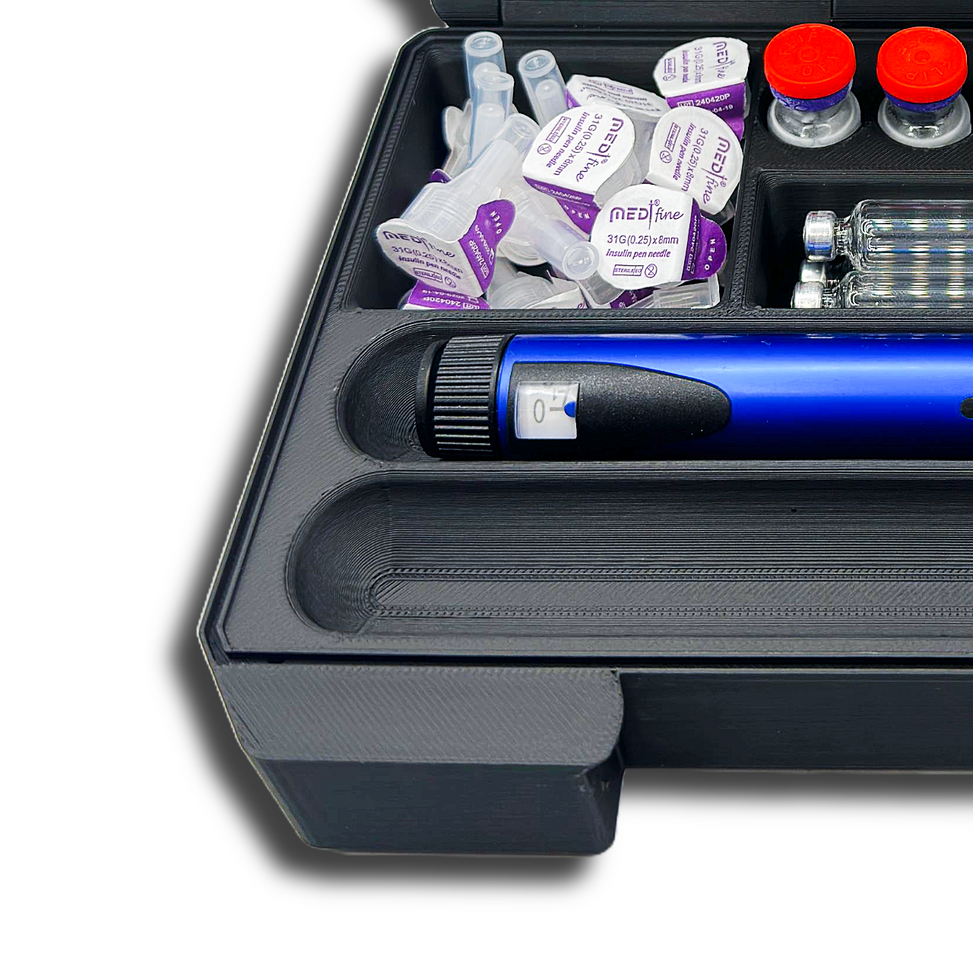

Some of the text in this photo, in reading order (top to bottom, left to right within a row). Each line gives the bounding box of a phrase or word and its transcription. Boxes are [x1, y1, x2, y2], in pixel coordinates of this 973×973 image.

[695, 93, 731, 106] 240420P
[562, 134, 574, 149] pen
[546, 148, 565, 168] needle
[679, 144, 687, 160] pen
[632, 251, 647, 260] pen
[648, 249, 671, 258] needle
[704, 238, 716, 270] OPEN
